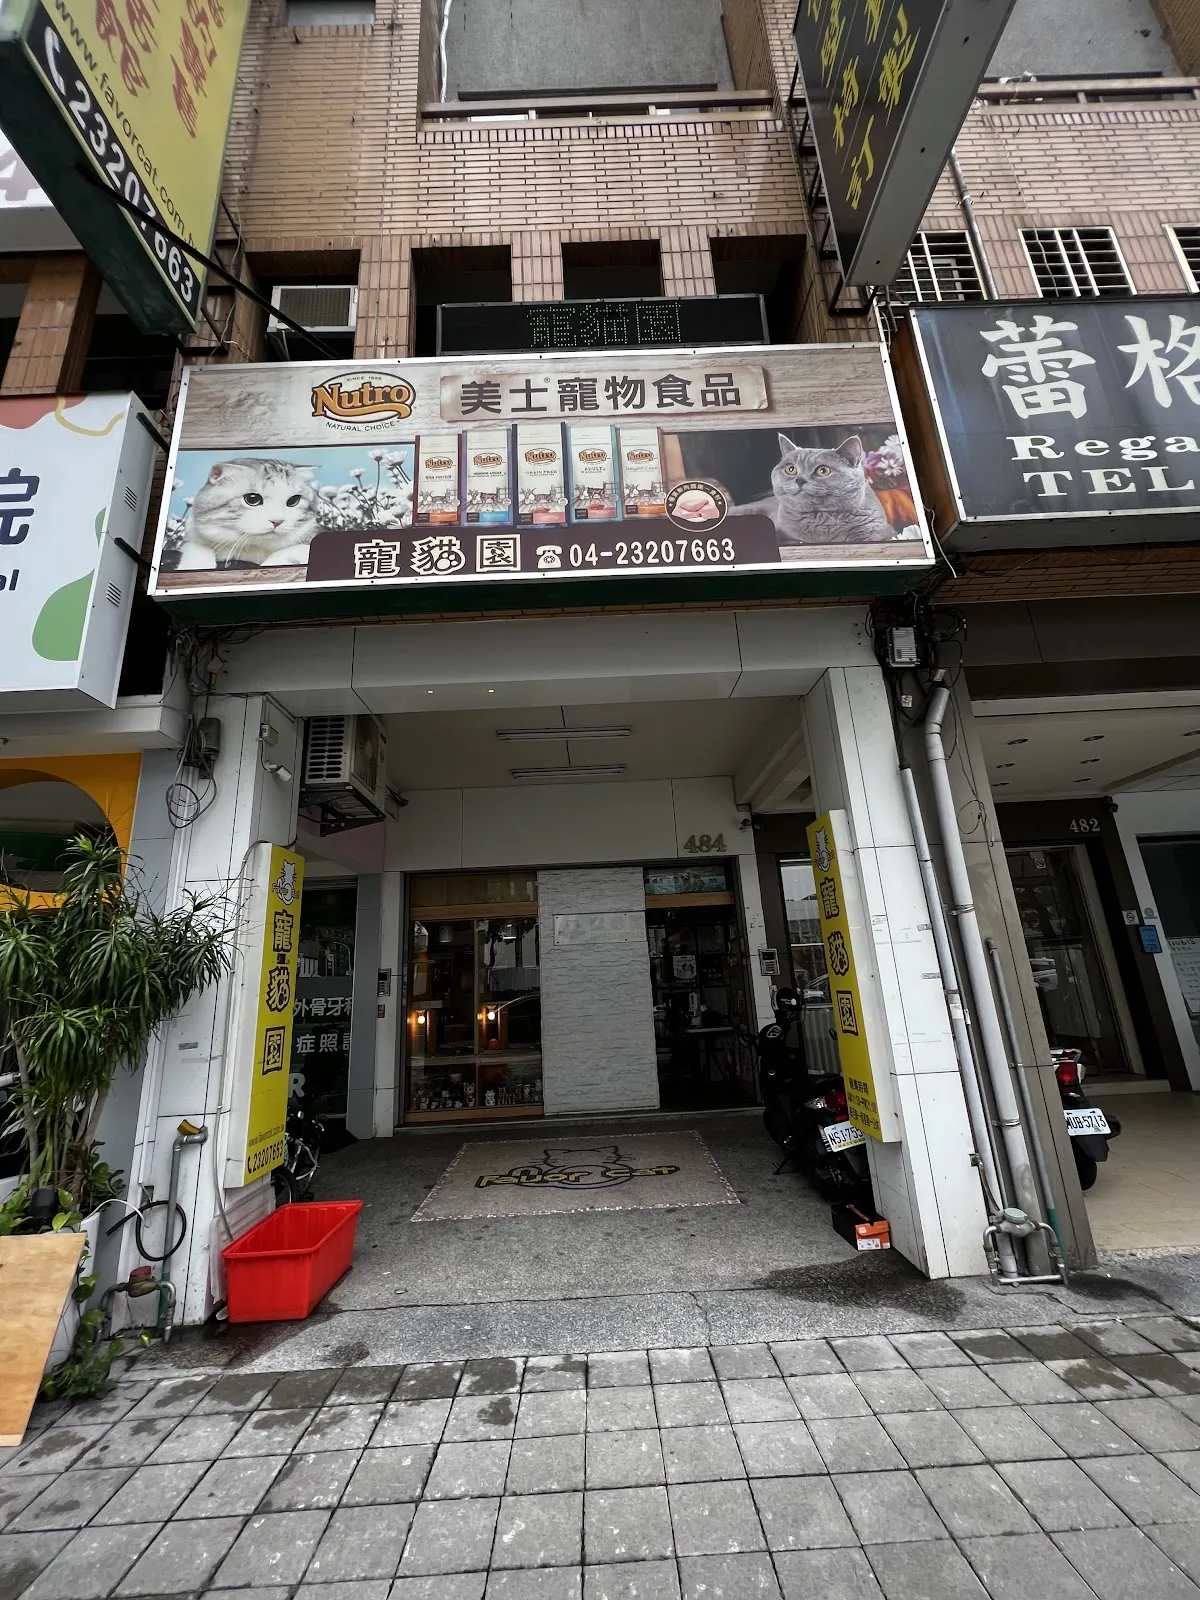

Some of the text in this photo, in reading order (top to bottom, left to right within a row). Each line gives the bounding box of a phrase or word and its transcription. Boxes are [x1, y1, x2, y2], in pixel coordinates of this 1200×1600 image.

[311, 380, 412, 419] Nutro
[460, 372, 742, 415] 美士寵物食品
[325, 421, 362, 432] NATURAL
[1022, 466, 1196, 497] TEL
[354, 534, 735, 578] 寵貓園 04-23207663
[684, 833, 727, 853] 484
[1069, 818, 1100, 832] 482
[819, 877, 859, 1037] 寵貓園
[262, 909, 294, 1076] 寵貓園
